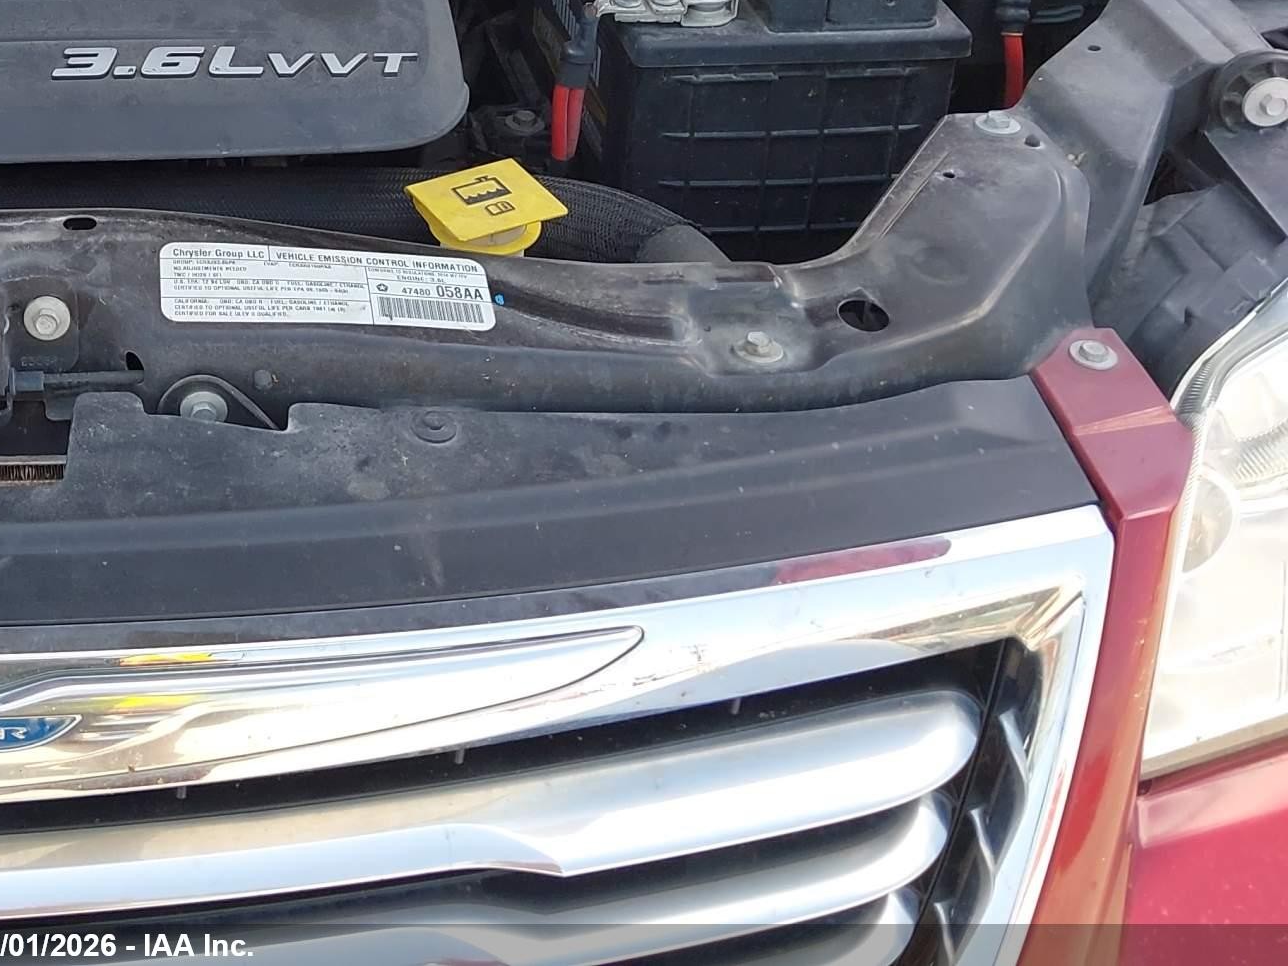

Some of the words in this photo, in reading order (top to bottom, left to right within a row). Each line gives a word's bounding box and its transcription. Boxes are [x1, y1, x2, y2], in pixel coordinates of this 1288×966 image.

[172, 248, 212, 259] Chrysler
[215, 249, 244, 260] Group
[247, 249, 265, 259] LLC
[276, 252, 314, 262] VEHICLE
[318, 253, 363, 265] EMISSION
[366, 257, 410, 268] CONTROL
[412, 260, 478, 273] INFORMATION
[402, 287, 431, 296] 47480
[435, 284, 484, 301] 058AA
